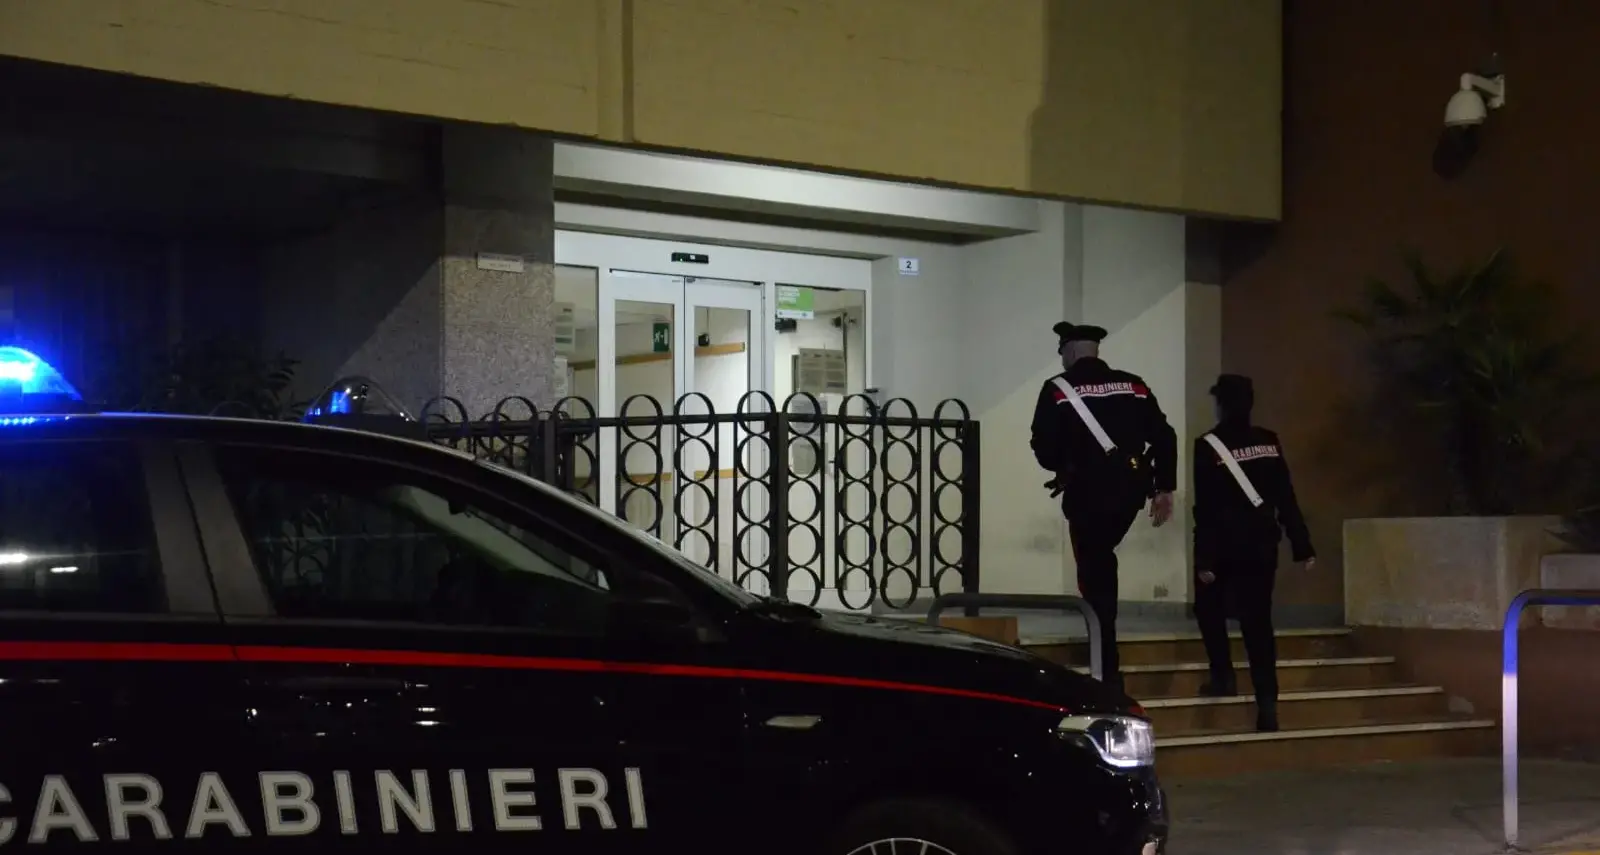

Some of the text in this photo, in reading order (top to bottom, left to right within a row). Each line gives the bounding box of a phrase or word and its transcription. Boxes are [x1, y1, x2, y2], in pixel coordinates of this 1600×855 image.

[905, 260, 913, 269] 2
[1074, 382, 1133, 395] CARABINIERI
[1231, 445, 1277, 459] RABINIERI
